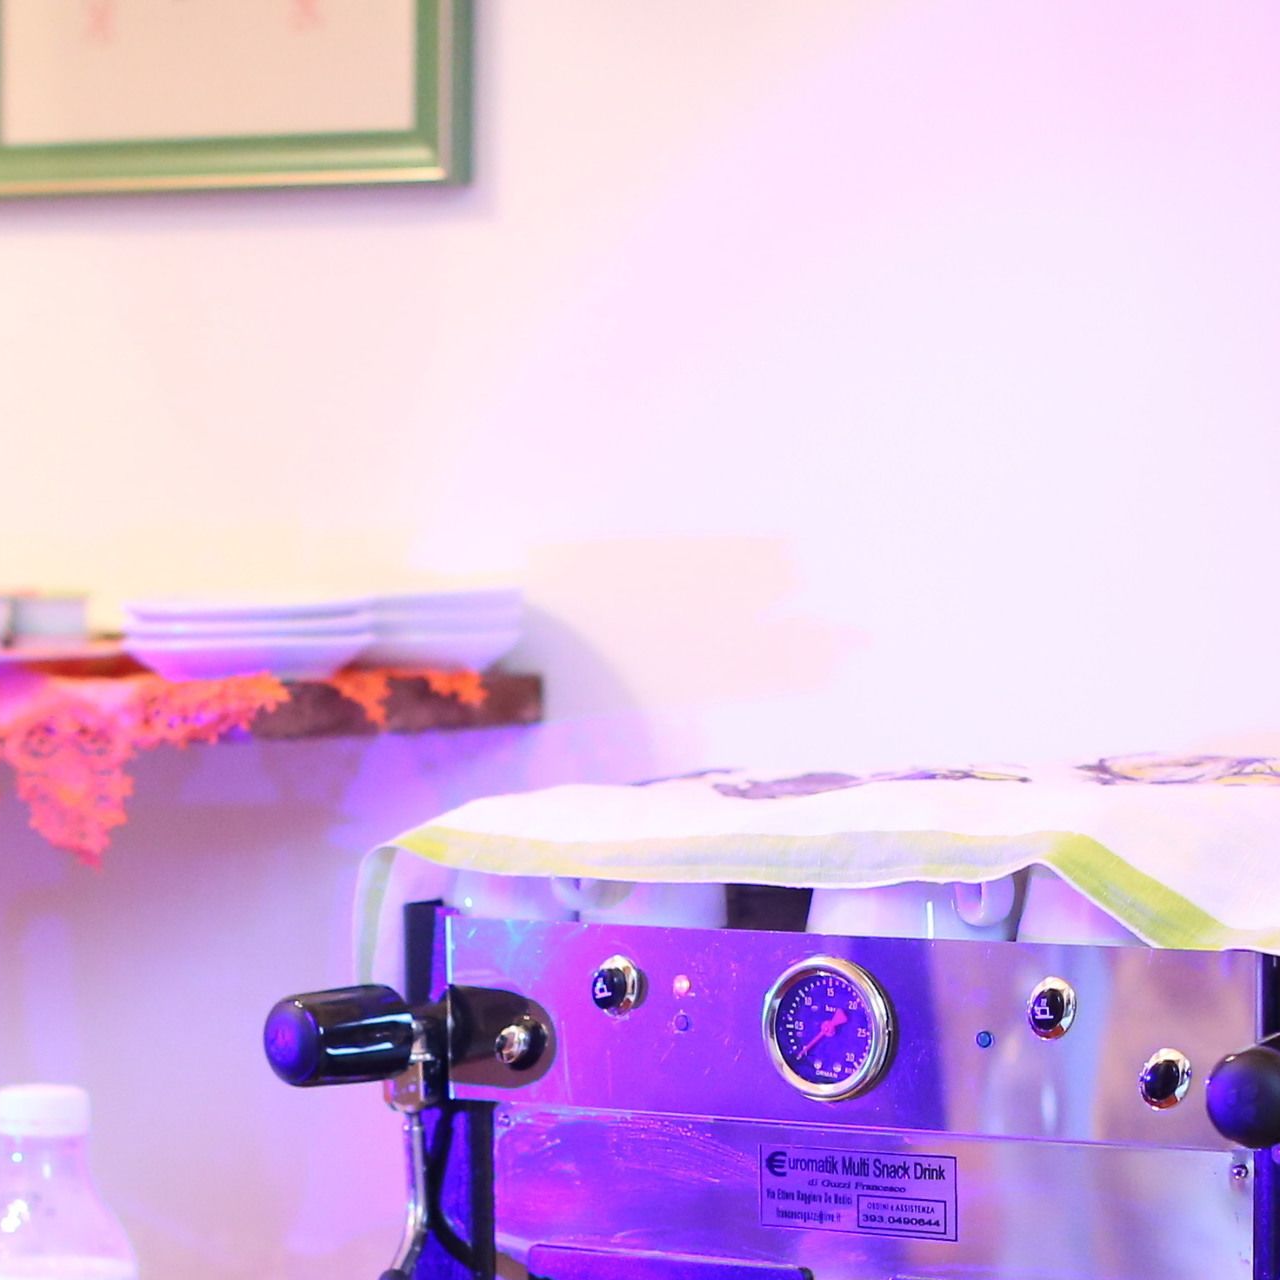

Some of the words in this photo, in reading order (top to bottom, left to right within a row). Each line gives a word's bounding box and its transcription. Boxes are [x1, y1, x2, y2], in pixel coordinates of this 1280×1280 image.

[841, 1156, 869, 1177] Multi
[873, 1158, 911, 1180] Snack
[914, 1162, 946, 1180] Drink
[808, 1178, 818, 1186] di
[821, 1179, 852, 1189] Guzzi
[854, 1182, 906, 1193] Francesco
[766, 1188, 776, 1199] Via
[895, 1204, 935, 1214] ASSISTENZA
